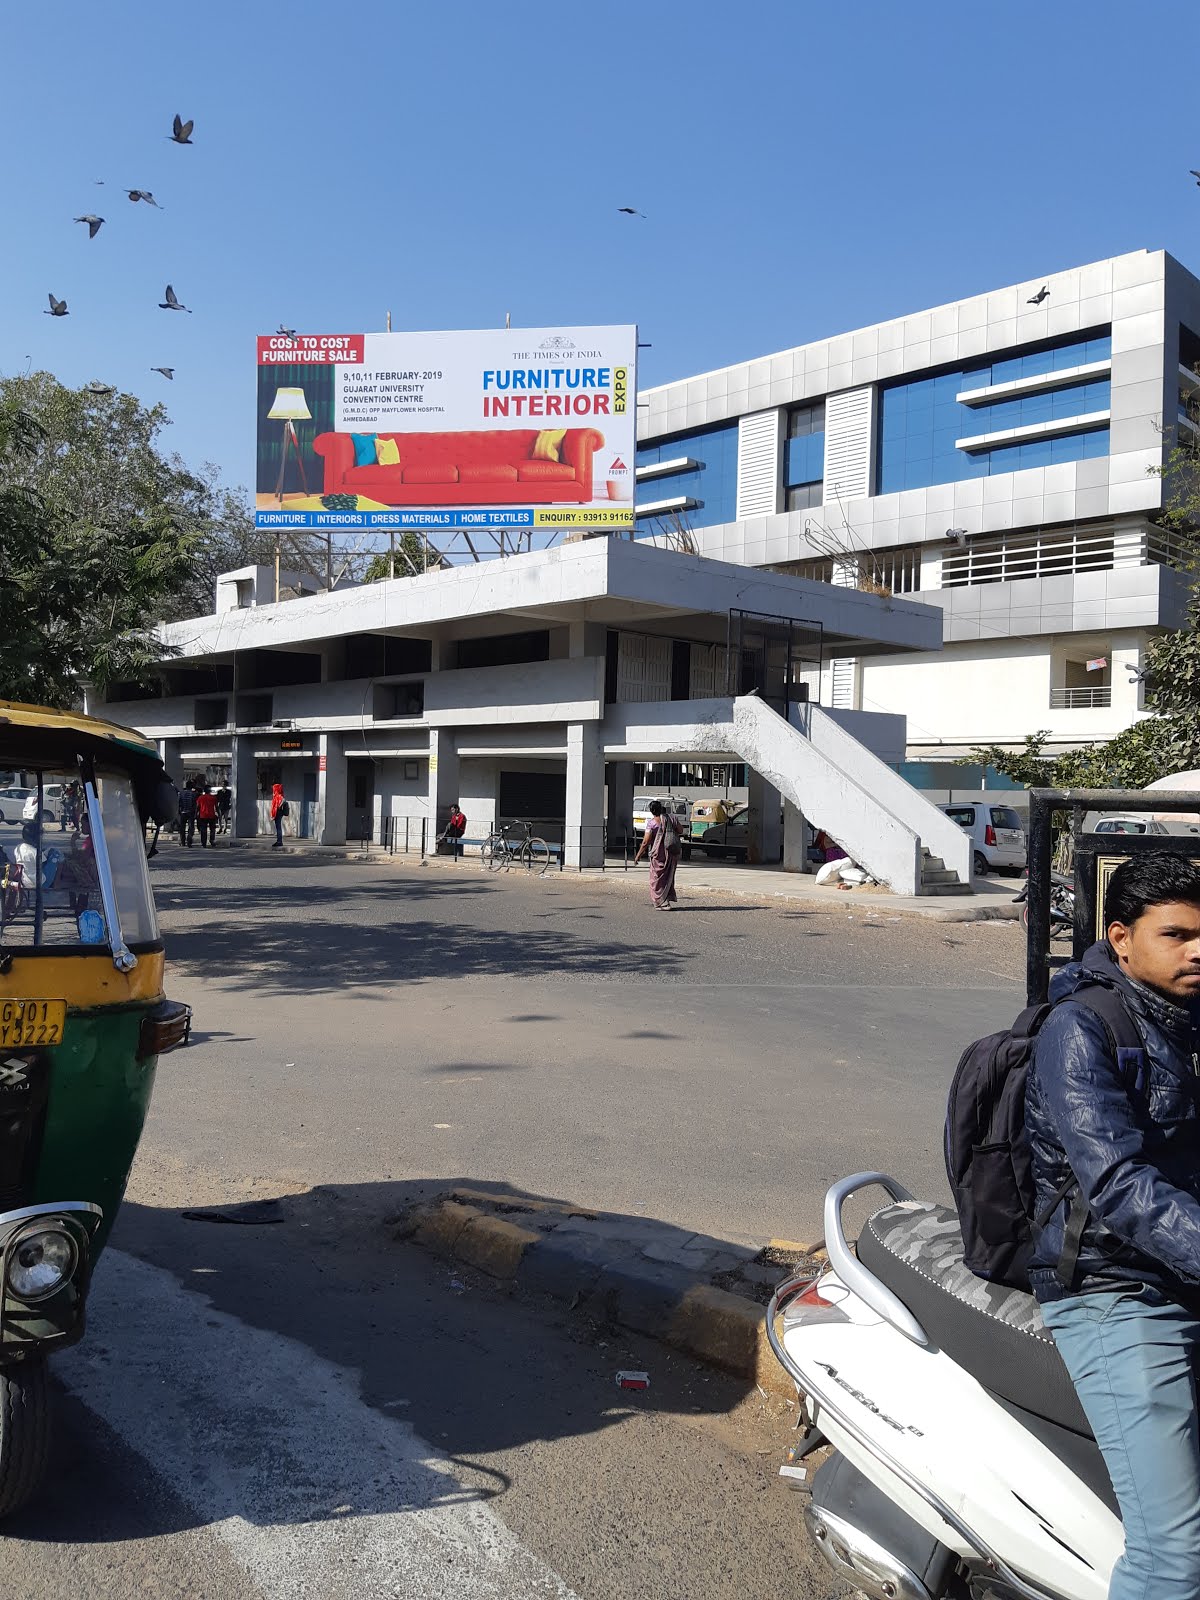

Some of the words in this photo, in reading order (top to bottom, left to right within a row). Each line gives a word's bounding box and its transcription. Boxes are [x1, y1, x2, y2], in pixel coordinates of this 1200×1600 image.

[269, 337, 299, 349] COST
[302, 337, 317, 349] TO
[320, 337, 351, 349] COST
[262, 350, 326, 362] FURNITURE
[328, 350, 357, 361] SALE
[512, 352, 531, 360] THE
[532, 351, 560, 360] TIMES
[562, 351, 575, 359] OF
[577, 350, 602, 358] INDIA
[343, 372, 373, 382] 9,10,11
[483, 367, 611, 390] FURNITURE
[343, 385, 377, 393] GUJARAT
[380, 384, 425, 393] UNIVERSITY
[615, 369, 626, 412] EXPO
[343, 395, 392, 404] CONVENTION
[394, 395, 424, 403] CENTRE
[483, 394, 610, 418] INTERIOR
[258, 514, 306, 524] FURNITURE
[317, 514, 362, 524] INTERIORS
[371, 514, 400, 524] DRESS
[402, 513, 450, 523] MATERIALS
[461, 513, 487, 523] HOME
[489, 513, 530, 522] TEXTILES
[539, 513, 576, 522] ENQUIRY
[583, 513, 608, 522] 93913
[609, 512, 634, 521] 91162
